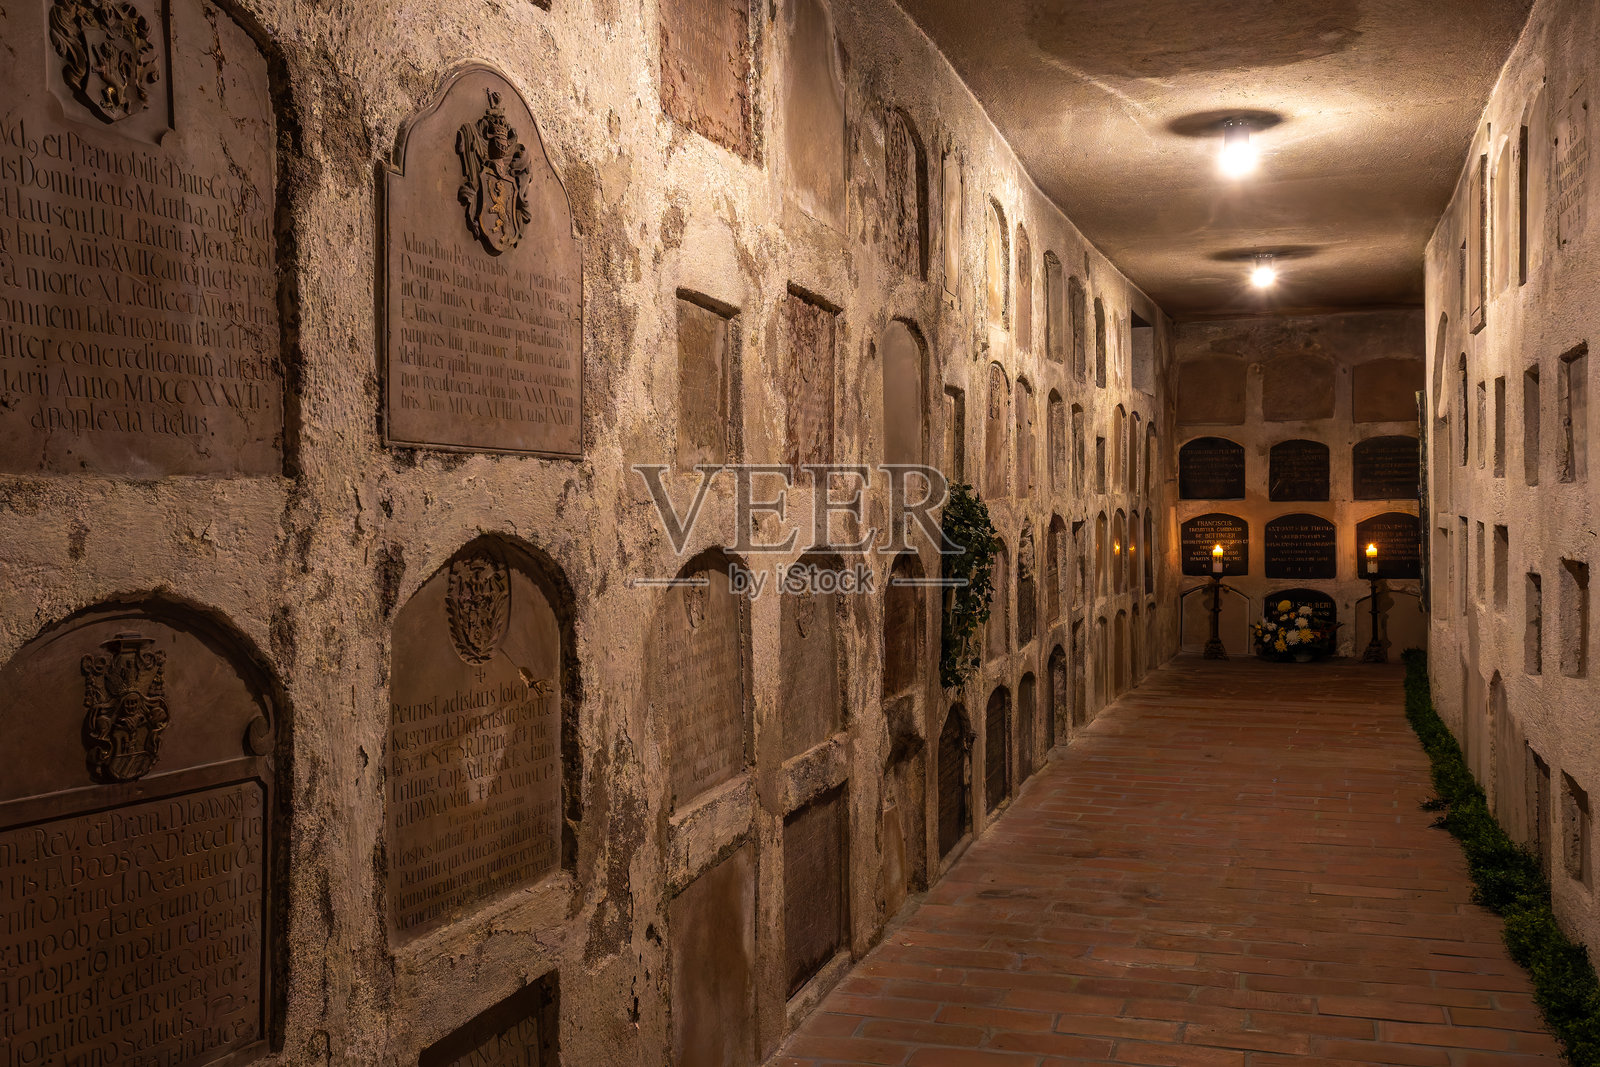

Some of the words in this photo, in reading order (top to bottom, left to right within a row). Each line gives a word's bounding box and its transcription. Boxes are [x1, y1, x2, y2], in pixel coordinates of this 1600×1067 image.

[19, 155, 134, 211] Dominicus
[56, 366, 120, 400] Anno
[31, 399, 144, 437] apoplexia
[61, 918, 92, 952] ob
[17, 944, 108, 1008] proprio
